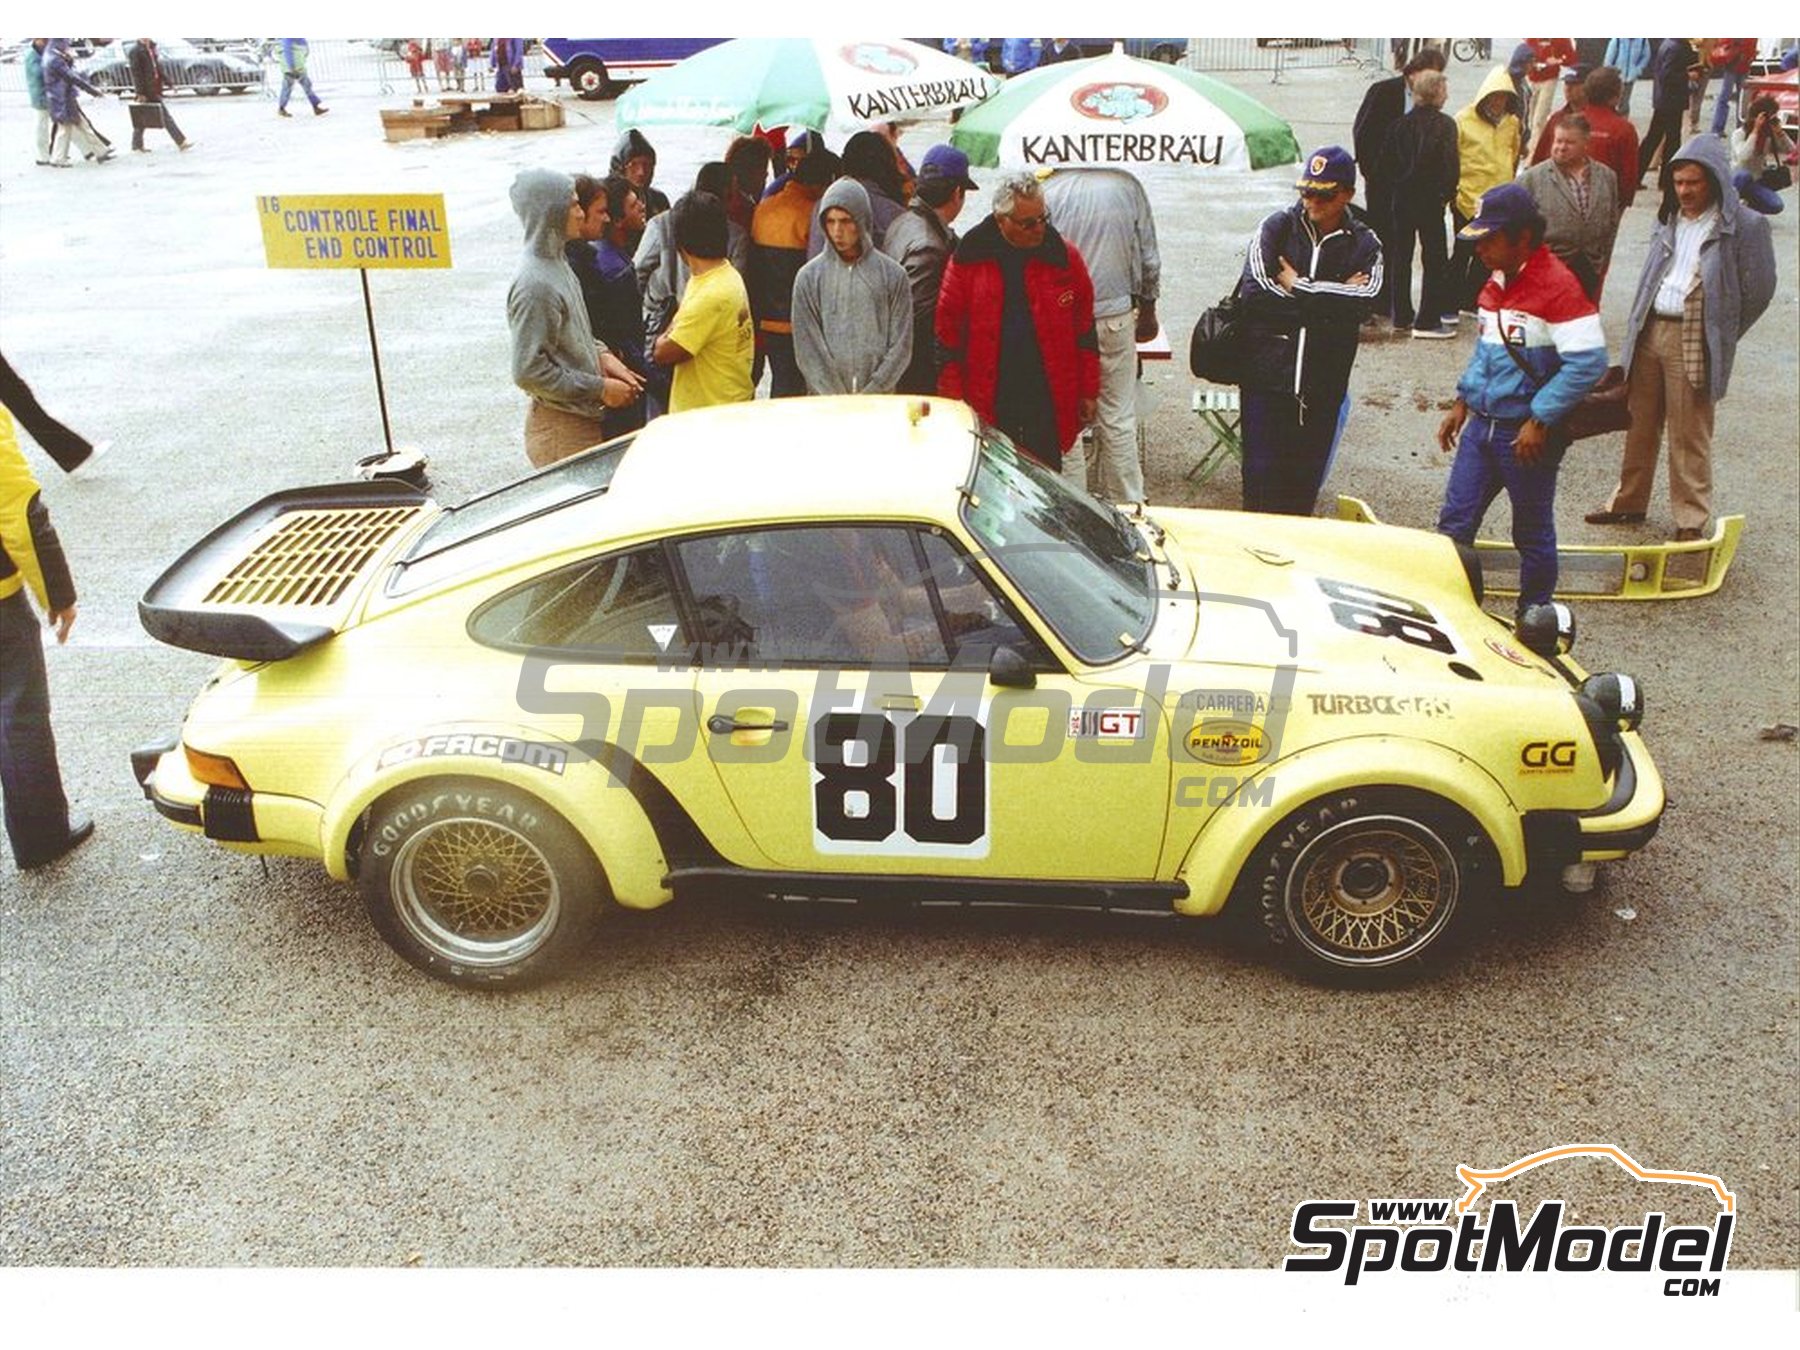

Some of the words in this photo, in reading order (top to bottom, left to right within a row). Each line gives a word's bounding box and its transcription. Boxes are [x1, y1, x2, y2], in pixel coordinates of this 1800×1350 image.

[848, 78, 987, 119] KANTERBRÄU
[1022, 134, 1223, 165] KANTERBRÄU
[284, 210, 379, 233] CONTROLE
[388, 209, 441, 232] FINAL
[305, 236, 342, 260] END
[353, 235, 438, 259] CONTROL
[1196, 694, 1265, 712] CARRERA
[1100, 713, 1141, 733] GT
[1191, 738, 1262, 749] PENNZOIL
[1521, 742, 1576, 767] GG
[813, 713, 986, 844] 80
